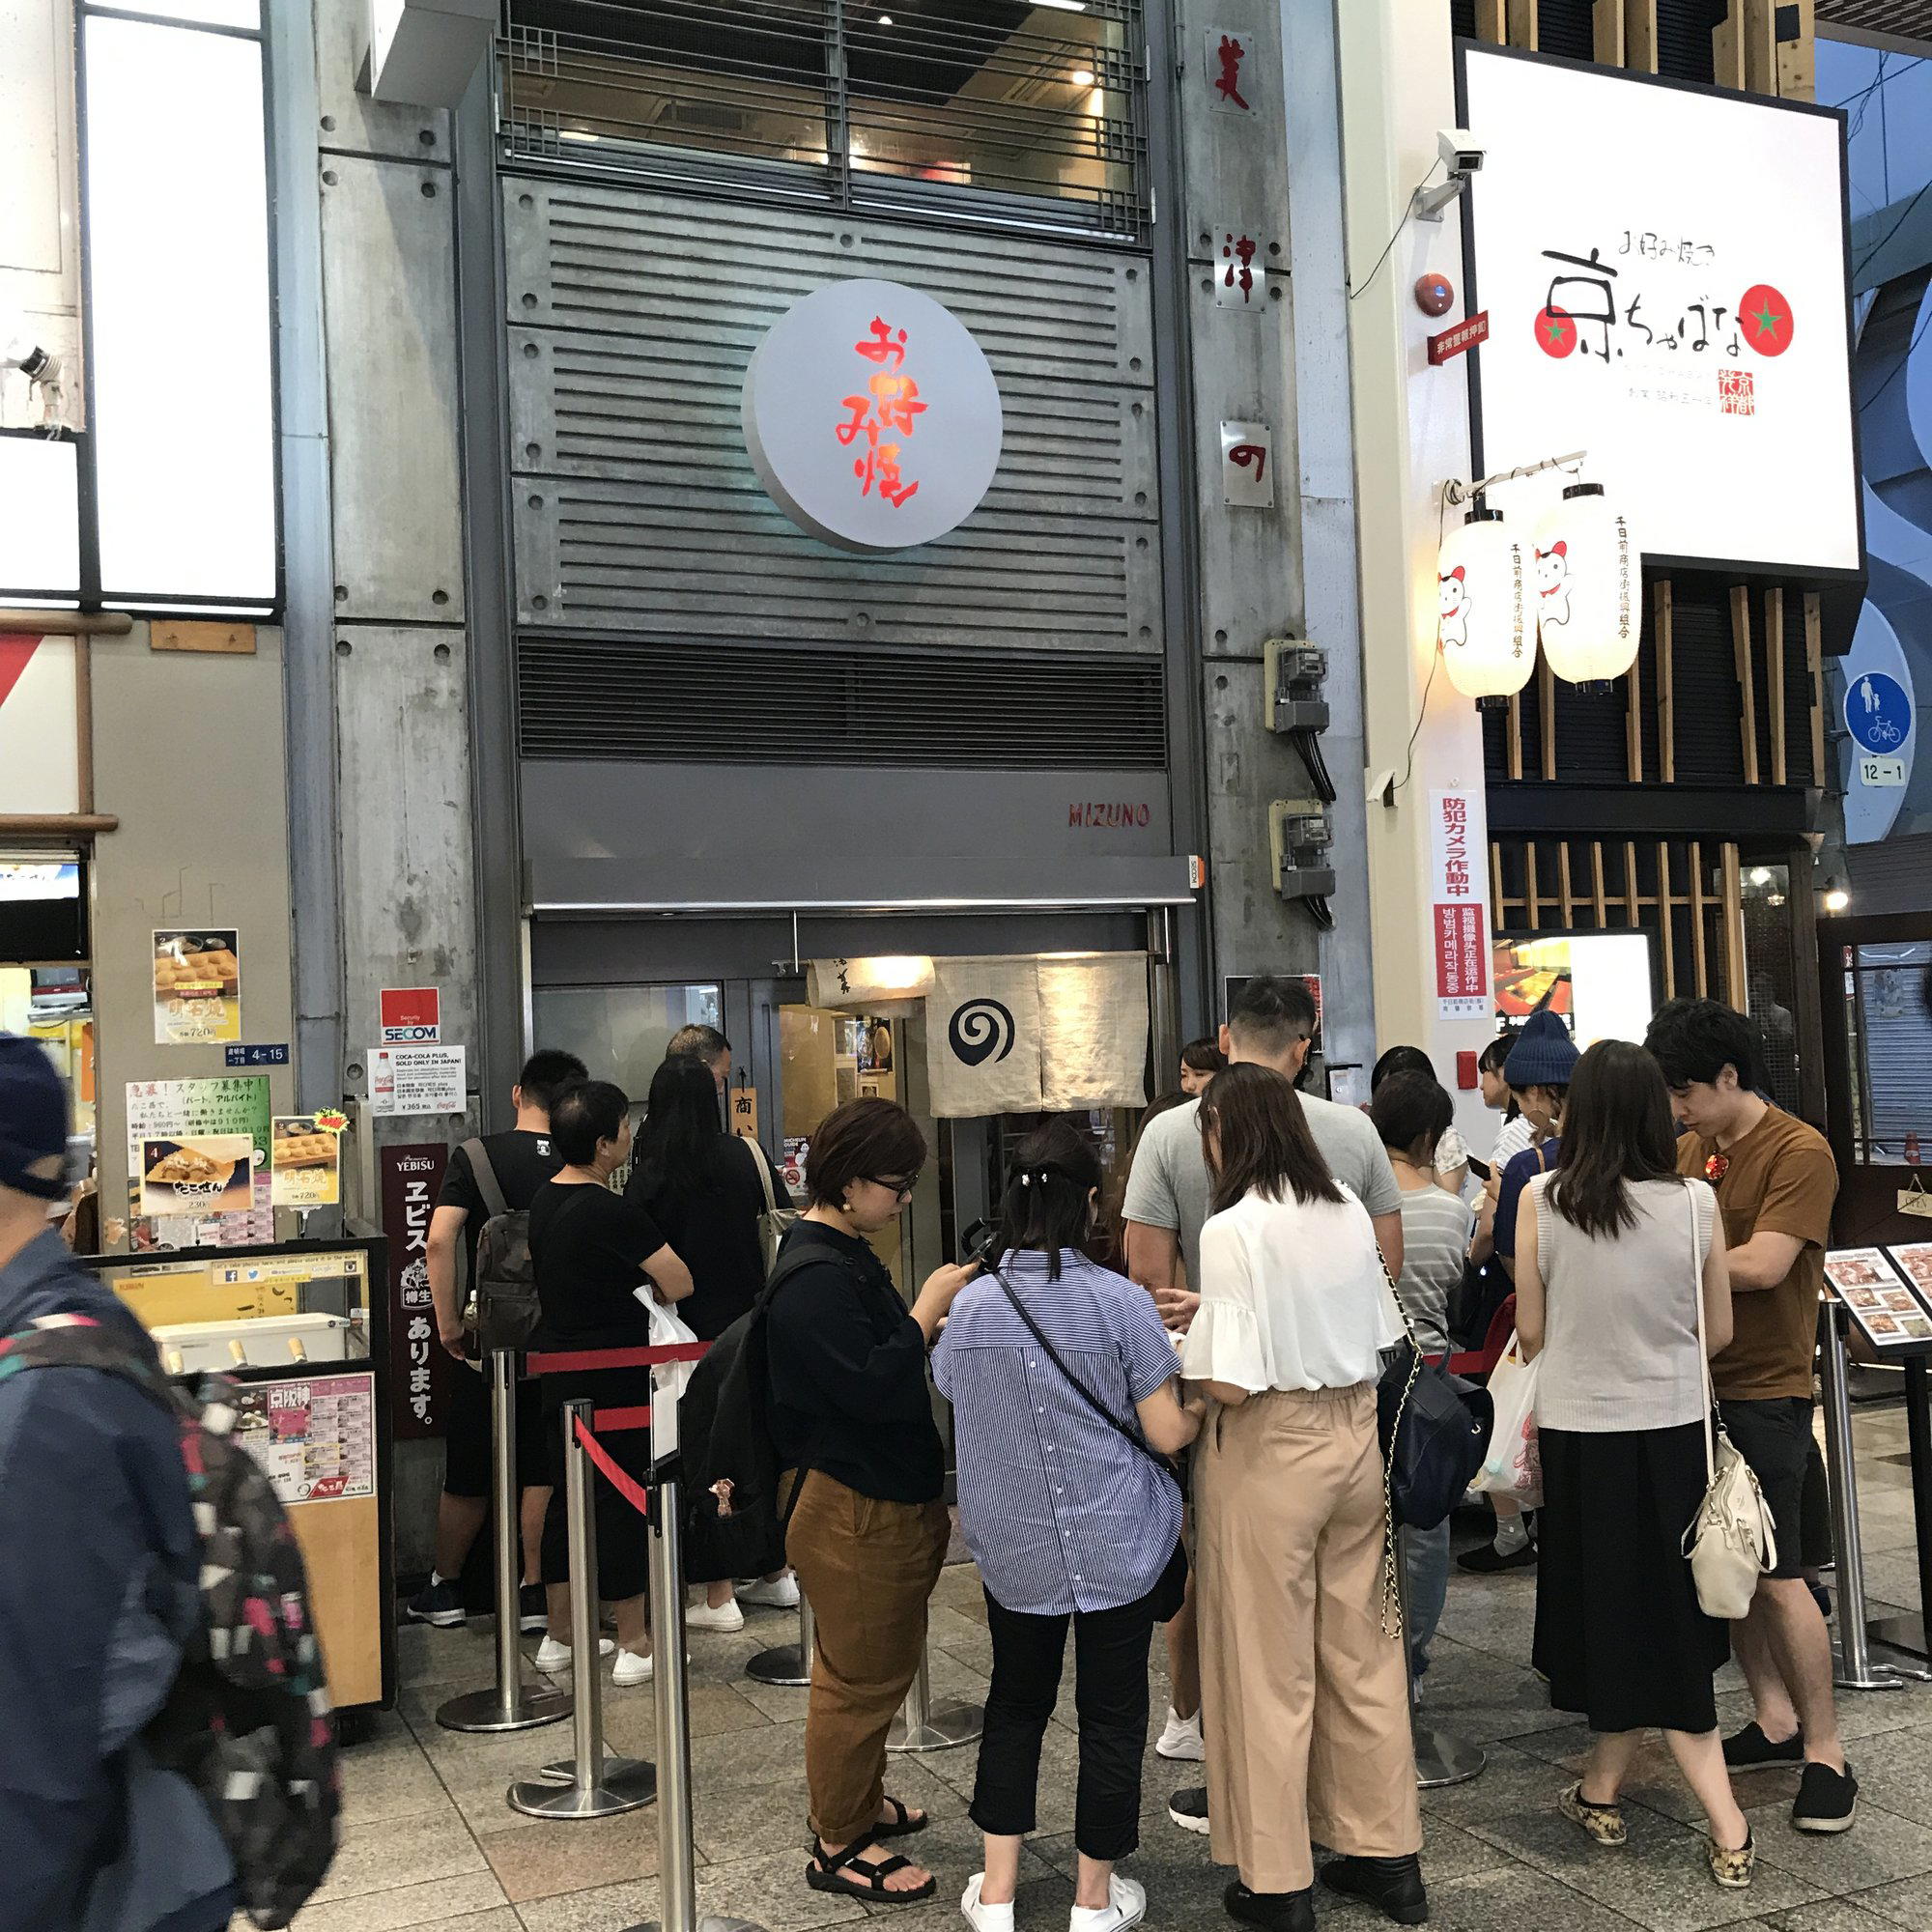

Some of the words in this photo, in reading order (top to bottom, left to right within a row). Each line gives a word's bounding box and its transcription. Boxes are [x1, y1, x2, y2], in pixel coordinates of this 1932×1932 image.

[1068, 803, 1151, 828] MIZUNO
[1442, 798, 1469, 896] 防犯カメラ作動中
[384, 1027, 437, 1040] SECOM
[251, 1048, 283, 1060] 4-15
[150, 1147, 158, 1158] 4
[397, 1160, 435, 1171] YEBISU
[406, 1290, 431, 1304] 樽生
[408, 1316, 433, 1425] あります。
